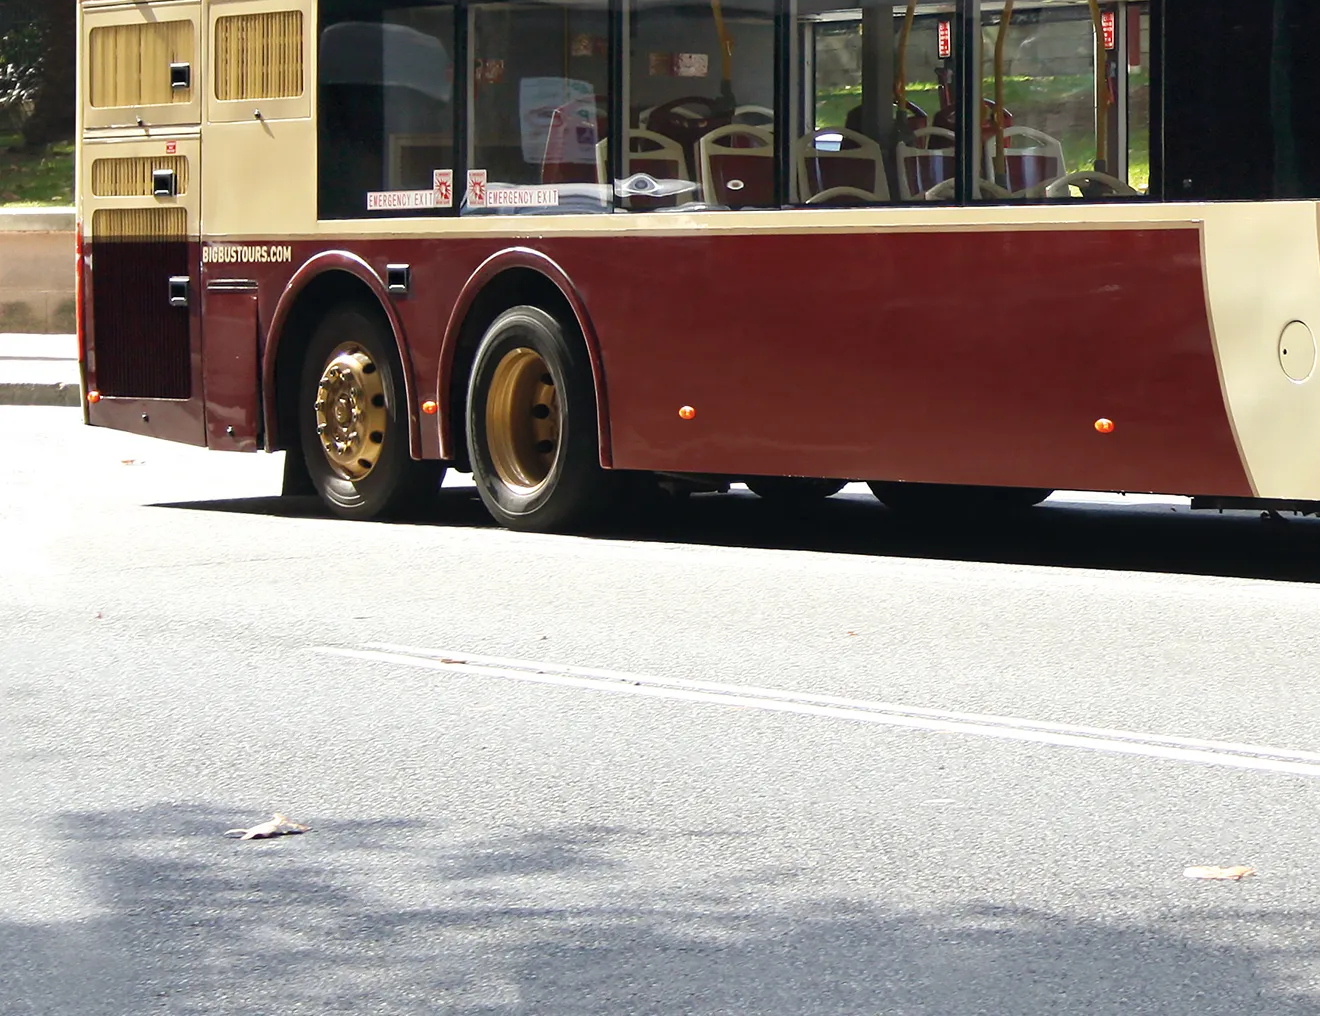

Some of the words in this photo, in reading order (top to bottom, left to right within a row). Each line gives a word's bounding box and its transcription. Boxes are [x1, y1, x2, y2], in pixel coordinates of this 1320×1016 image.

[369, 193, 412, 208] EMERGENCY
[414, 192, 433, 206] EXIT
[488, 191, 534, 205] EMERGENCY
[536, 190, 558, 204] EXIT
[202, 246, 292, 262] BIGBUSTOURS.COM
